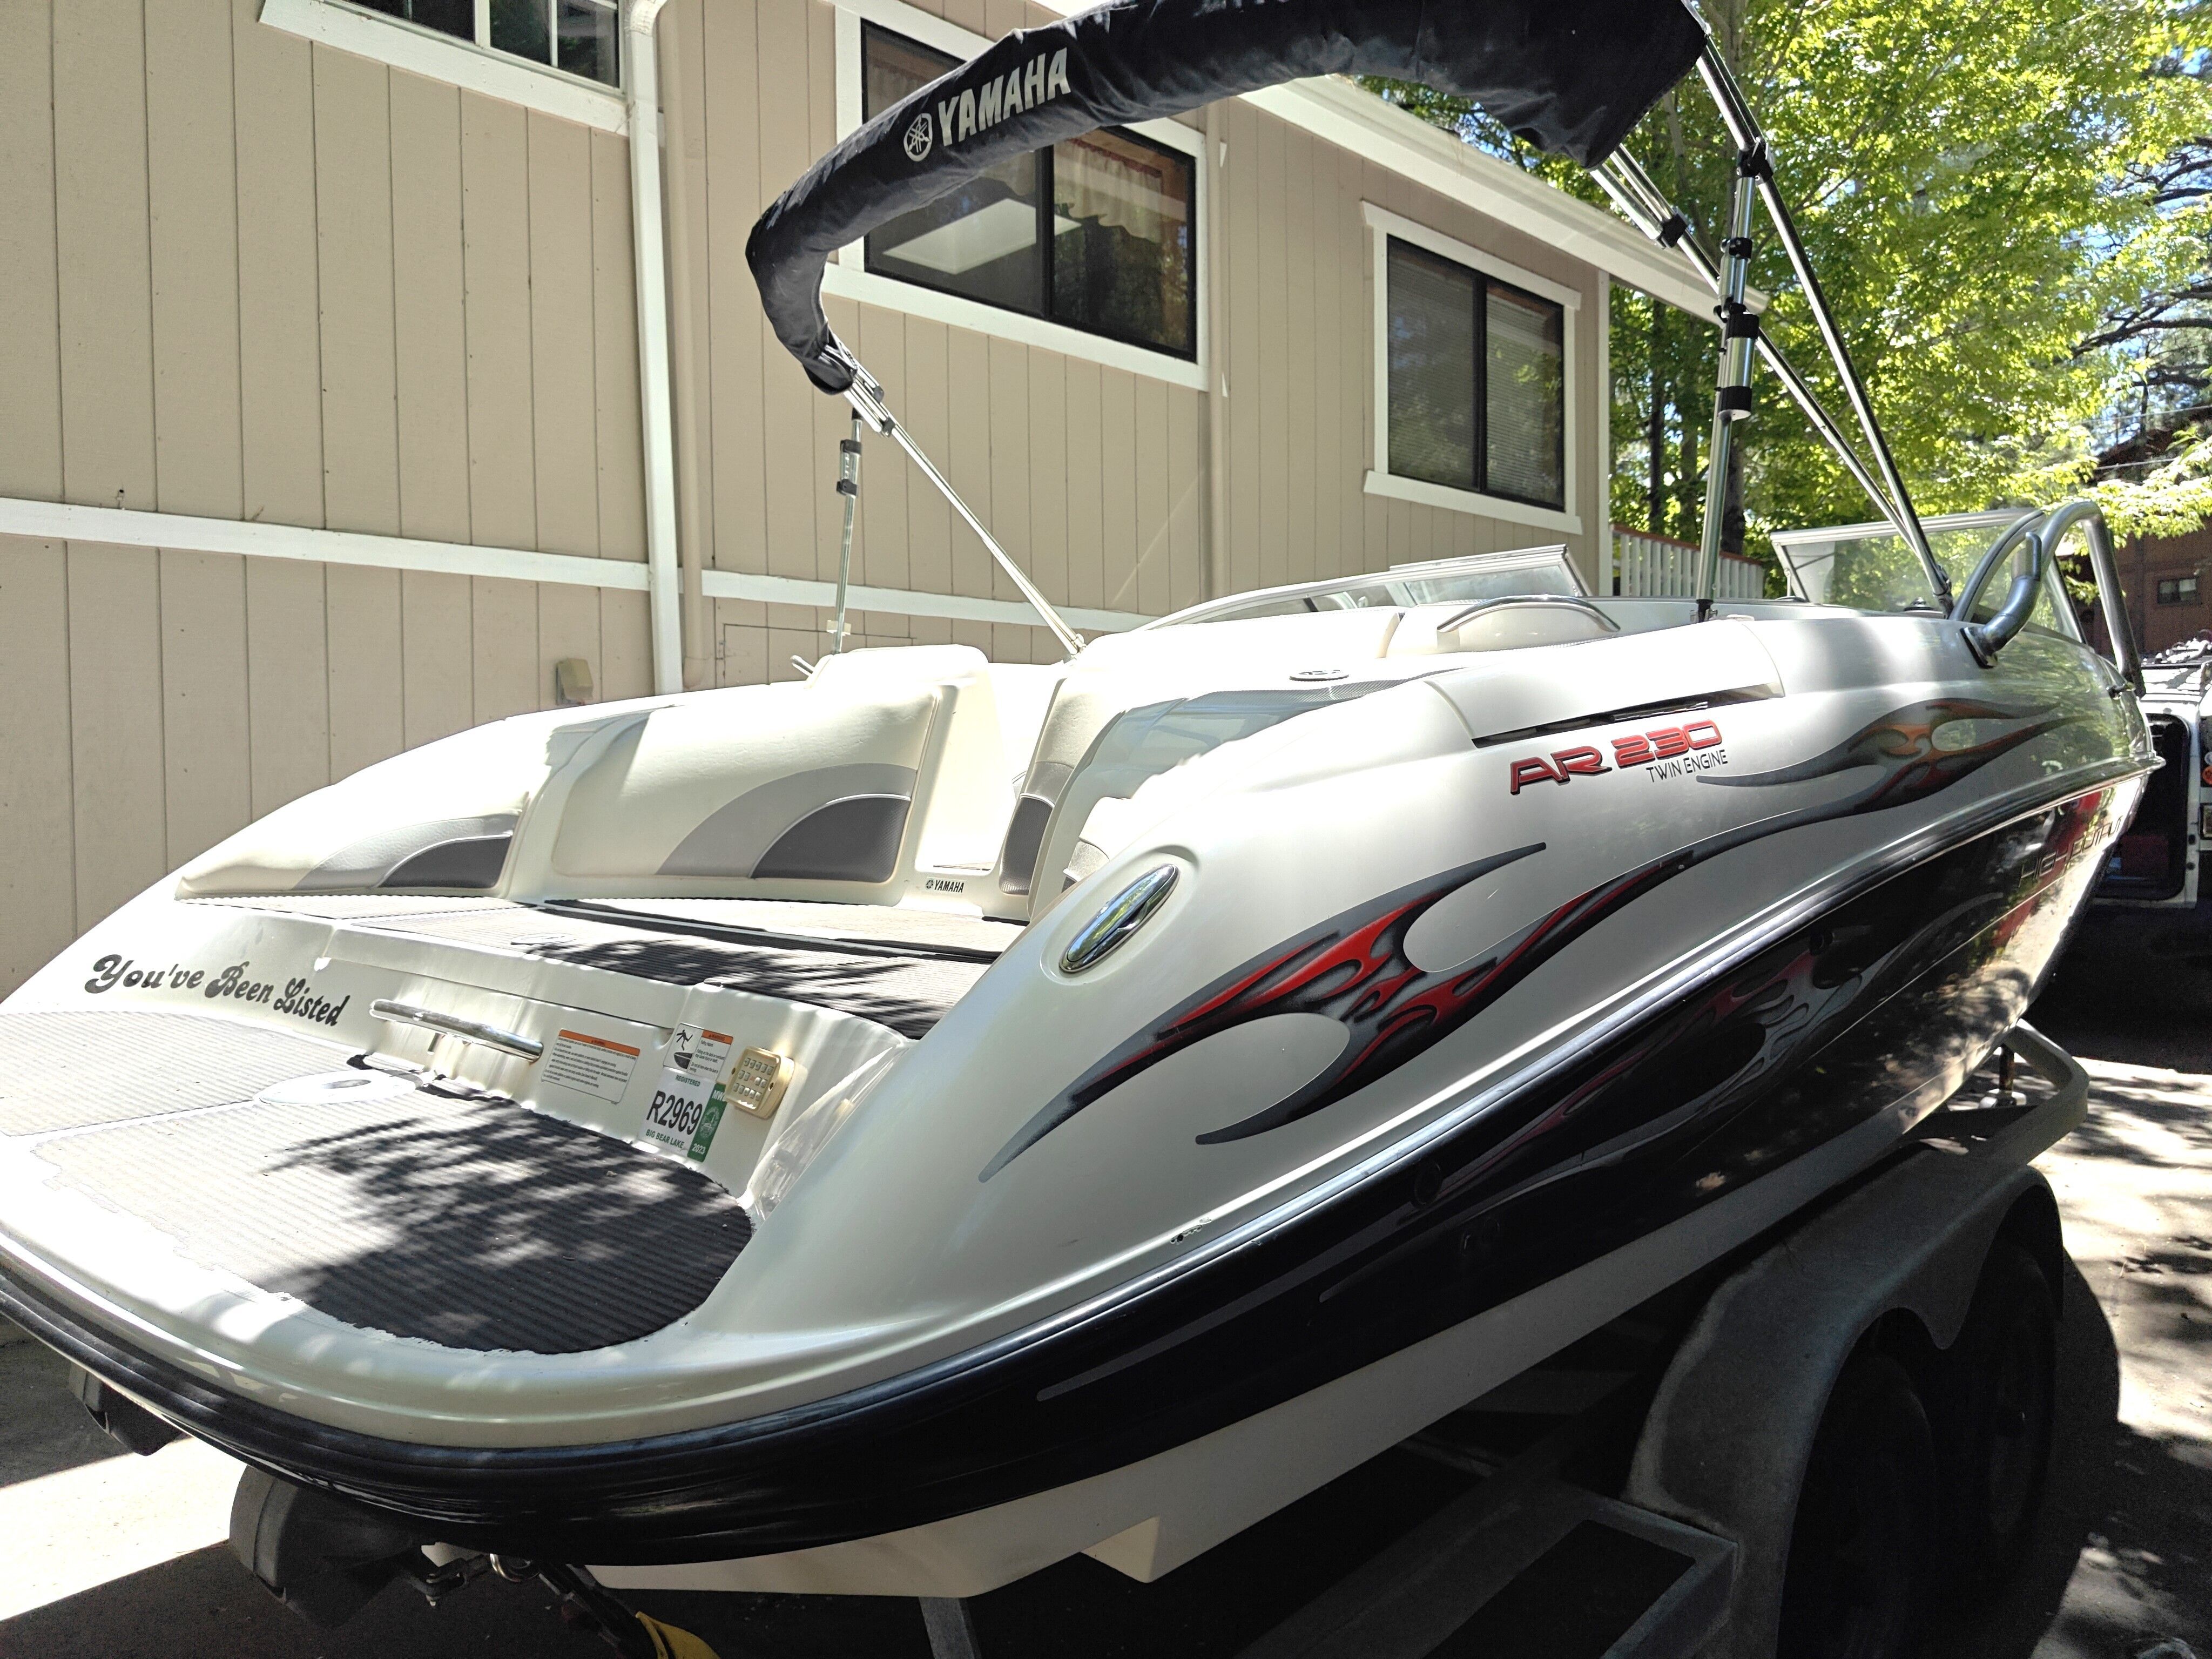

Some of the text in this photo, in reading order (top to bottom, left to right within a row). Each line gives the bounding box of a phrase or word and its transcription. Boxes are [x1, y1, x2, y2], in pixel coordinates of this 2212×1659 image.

[938, 48, 1071, 146] YAMAHA
[1510, 719, 1723, 795] AR 230
[1646, 749, 1729, 783] TWIN ENGINE
[935, 880, 964, 893] YAMAHA
[84, 954, 350, 1027] You've Been Listed
[675, 1075, 701, 1087] REGISTERED
[646, 1090, 703, 1136] R2969
[645, 1129, 685, 1149] BIG BEAR LAKE
[692, 1143, 706, 1155] 2023
